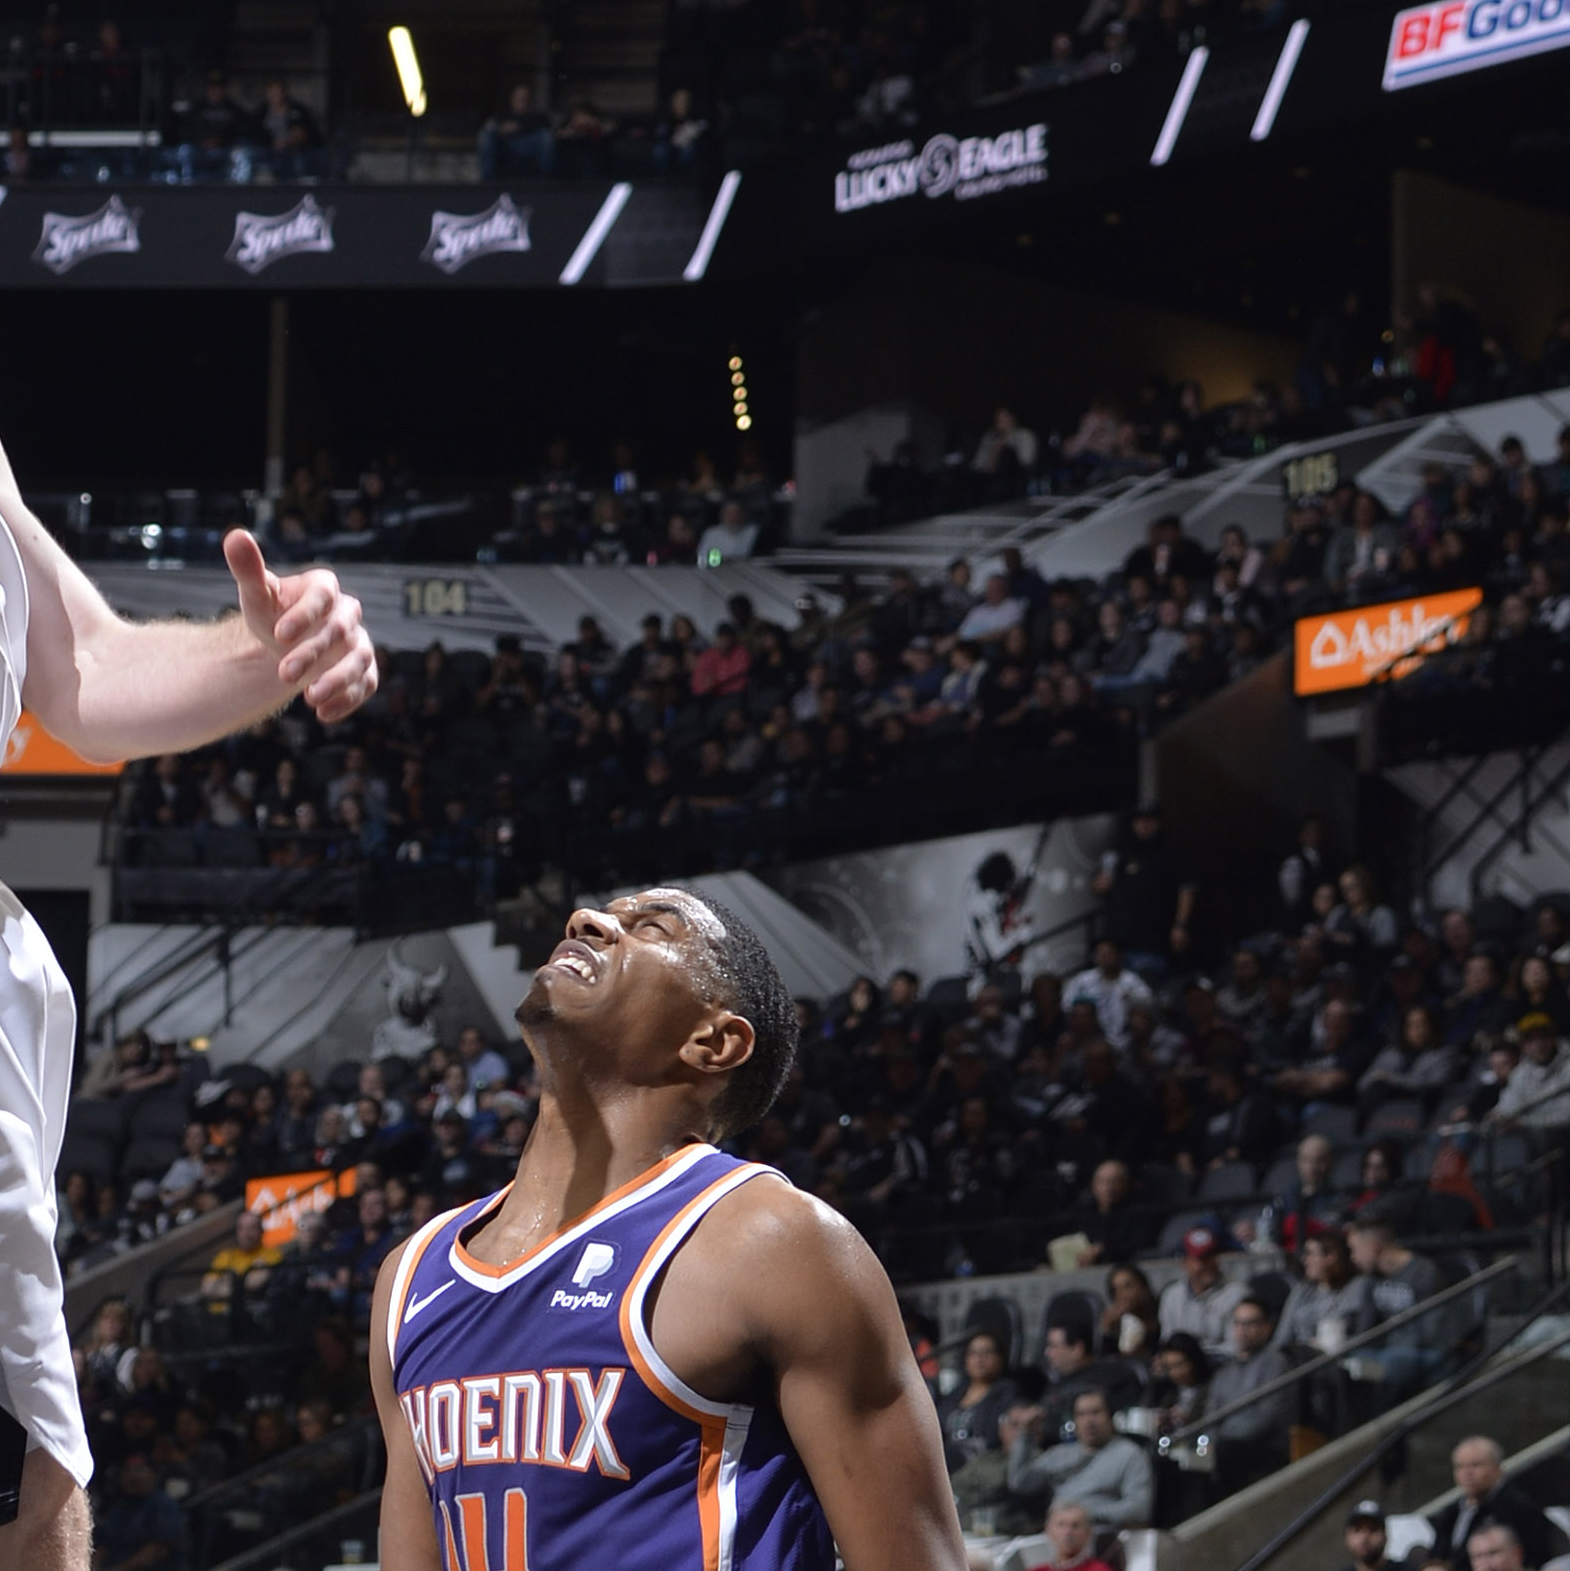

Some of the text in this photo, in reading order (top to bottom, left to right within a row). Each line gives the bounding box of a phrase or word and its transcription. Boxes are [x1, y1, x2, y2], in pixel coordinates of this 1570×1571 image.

[835, 153, 921, 213] LUCKY
[959, 122, 1048, 180] EAGLE
[406, 579, 466, 616] 104
[550, 1290, 613, 1311] PayPal
